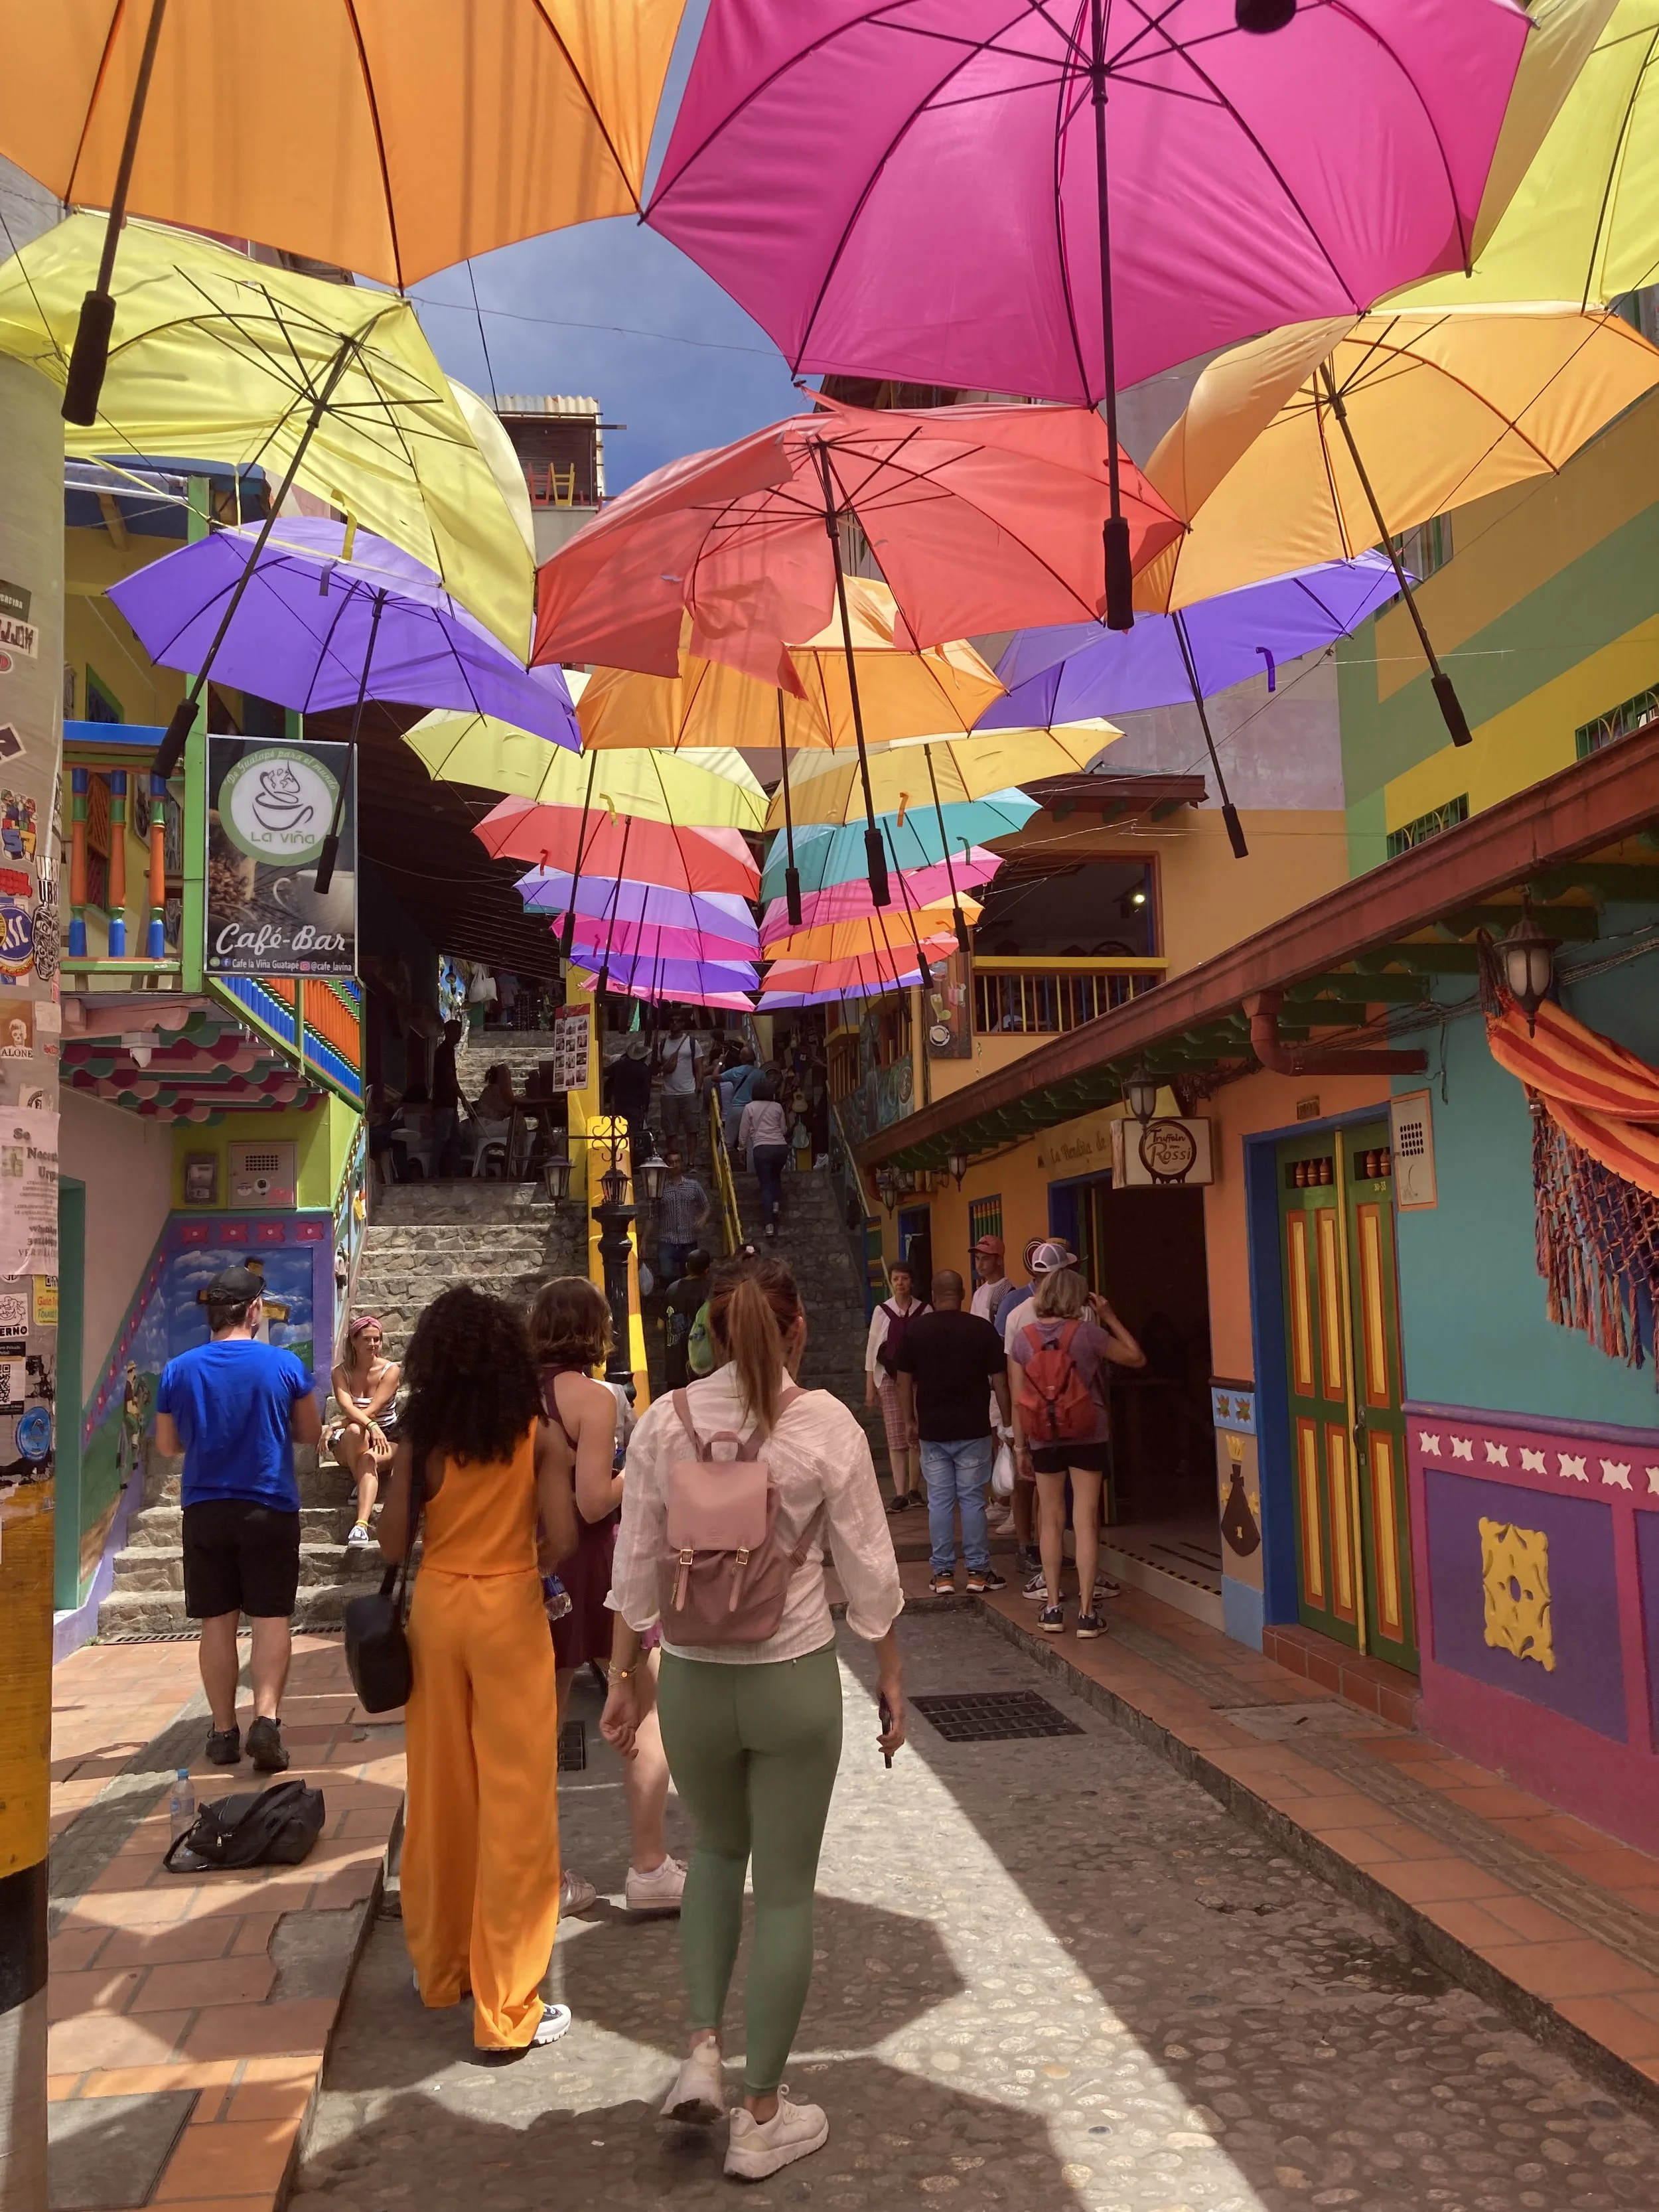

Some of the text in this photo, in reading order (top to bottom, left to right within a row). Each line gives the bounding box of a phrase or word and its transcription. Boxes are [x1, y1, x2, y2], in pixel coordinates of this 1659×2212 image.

[277, 750, 303, 761] para
[303, 756, 315, 765] el
[312, 764, 338, 790] mundo
[216, 922, 346, 956] Café-Bar
[232, 959, 247, 969] Cafe
[248, 960, 254, 968] la
[255, 960, 271, 969] Viña
[271, 960, 299, 972] Guatapé
[1, 1049, 33, 1059] ALONE
[1147, 1142, 1191, 1167] Rossi
